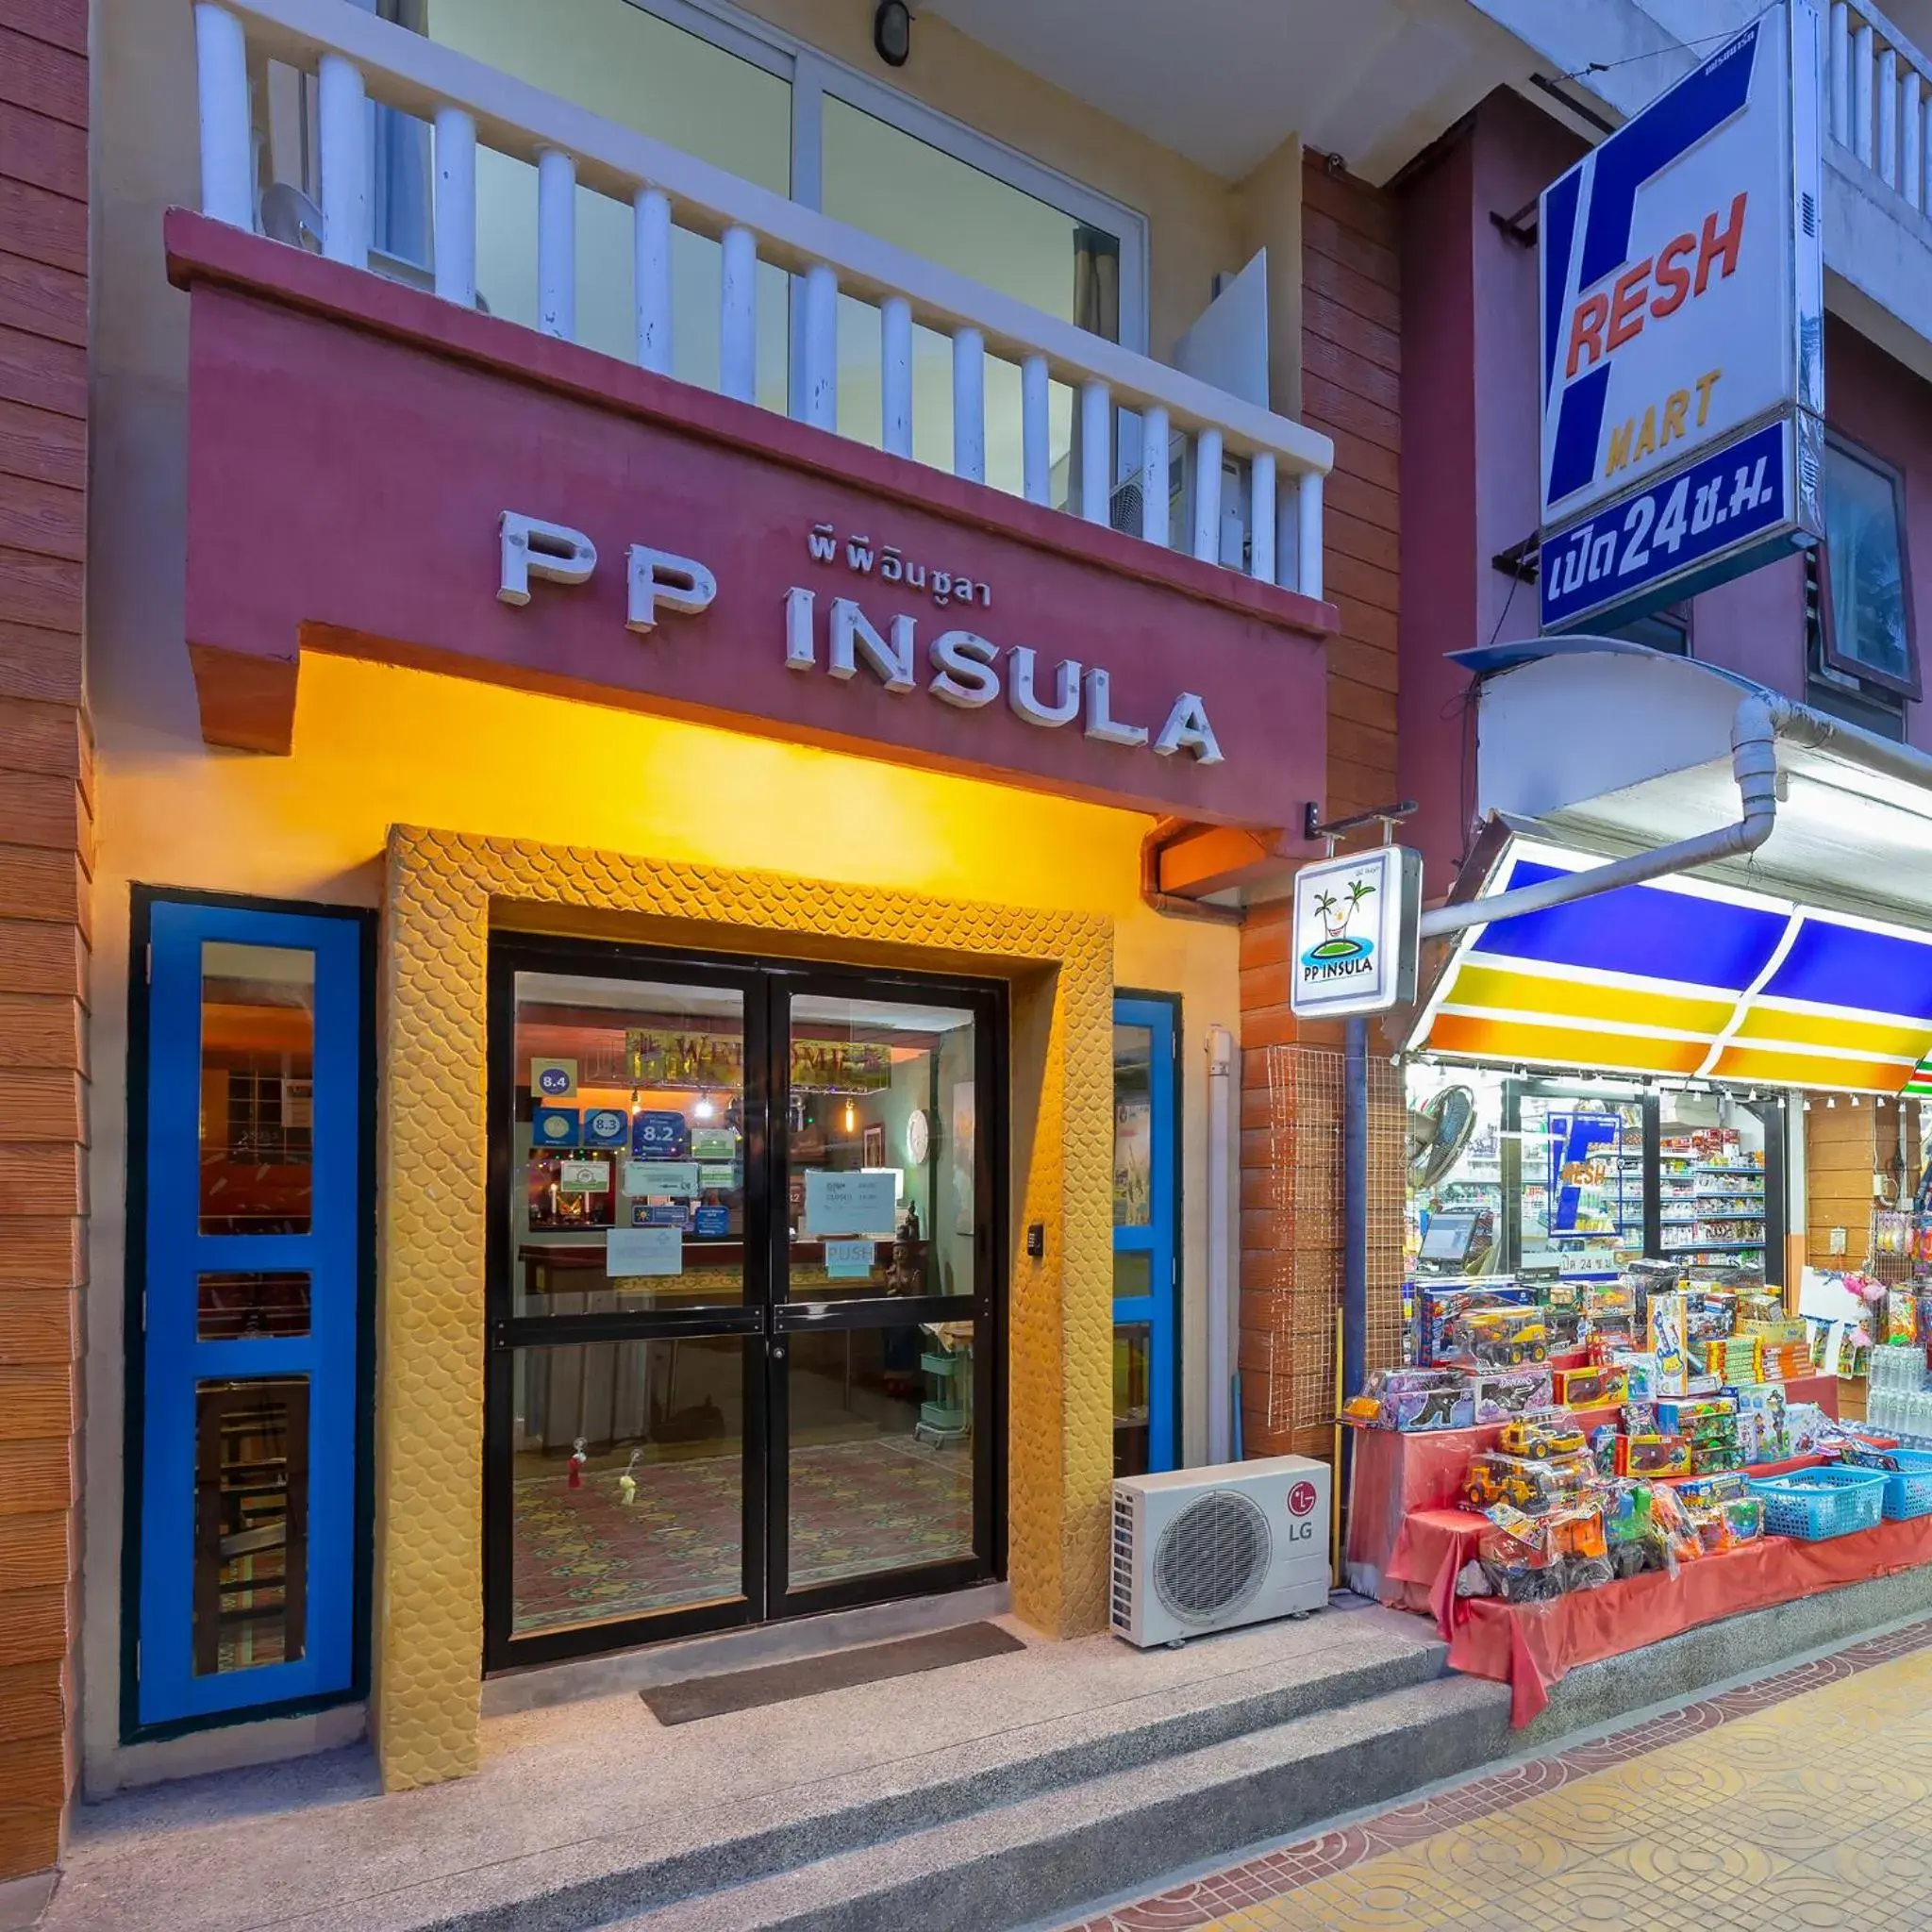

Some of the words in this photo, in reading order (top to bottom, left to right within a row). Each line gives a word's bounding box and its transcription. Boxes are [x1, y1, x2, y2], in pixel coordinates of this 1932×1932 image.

[1604, 369, 1722, 477] MART
[784, 586, 1224, 766] INSULA
[1304, 966, 1319, 981] PP
[1323, 957, 1374, 978] INSULA
[542, 1075, 567, 1088] 8.4
[594, 1119, 618, 1131] 8.3
[642, 1125, 675, 1142] 8.2
[1289, 1522, 1312, 1542] LG
